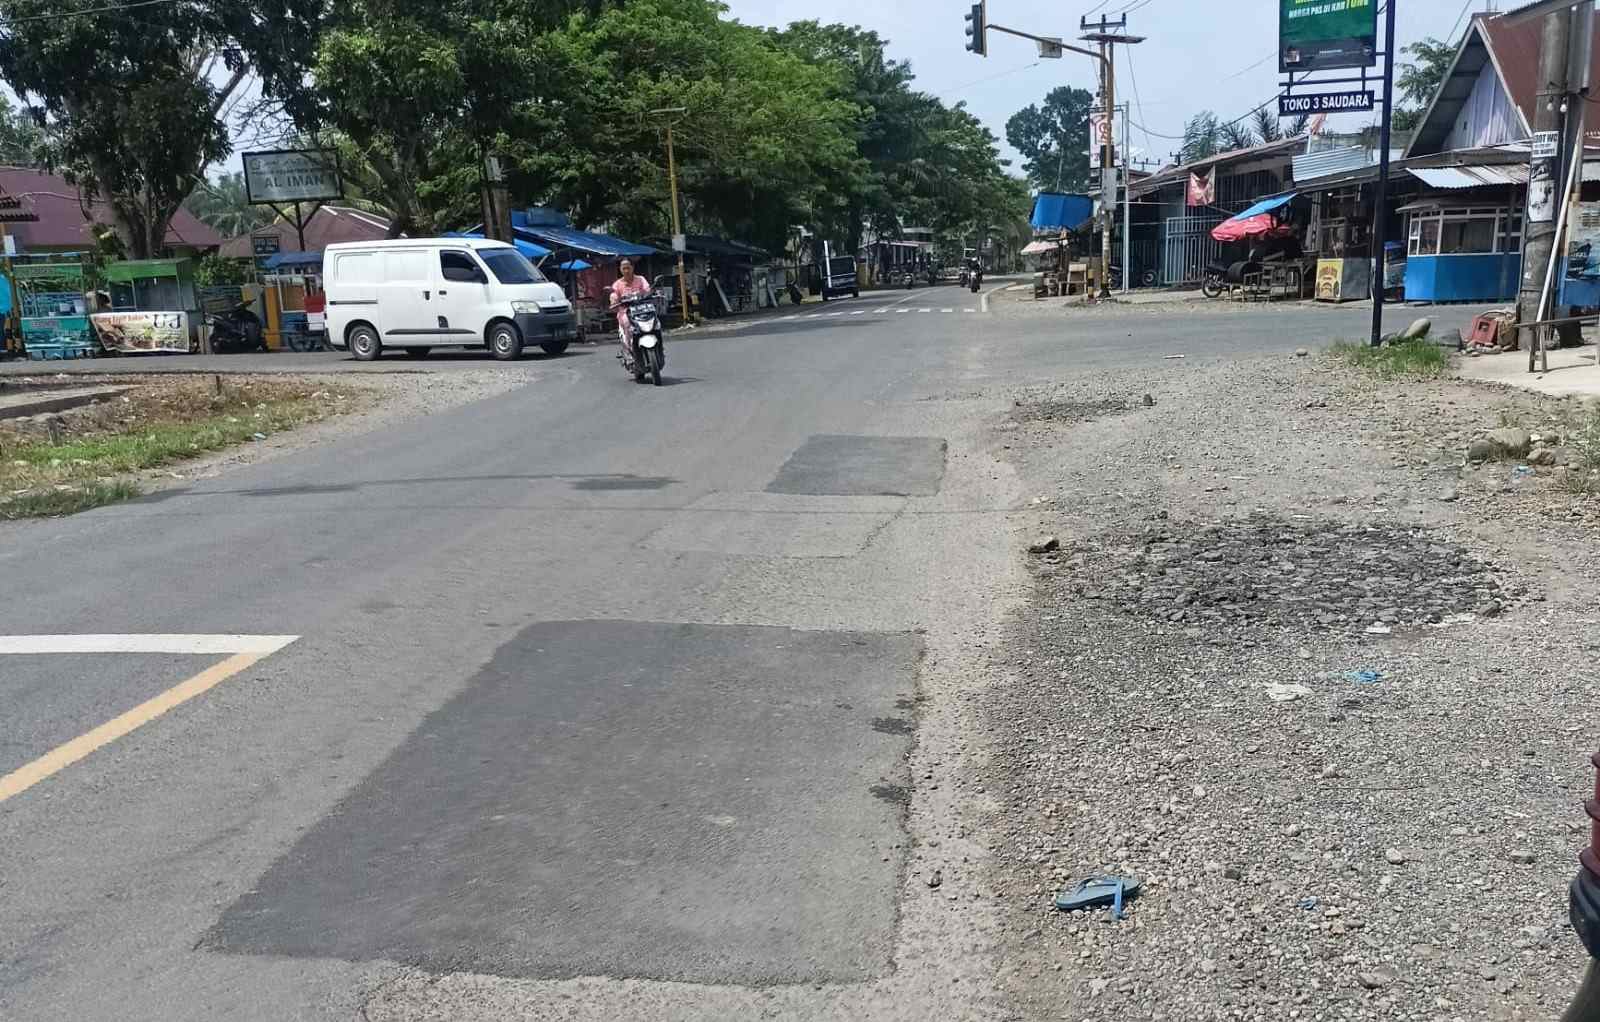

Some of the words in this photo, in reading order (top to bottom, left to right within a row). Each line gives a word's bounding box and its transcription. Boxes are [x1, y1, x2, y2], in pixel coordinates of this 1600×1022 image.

[1283, 98, 1311, 111] TOKO
[1313, 97, 1320, 109] 3
[1322, 94, 1369, 108] SAUDARA
[264, 175, 282, 188] AL
[287, 174, 325, 187] IMAN
